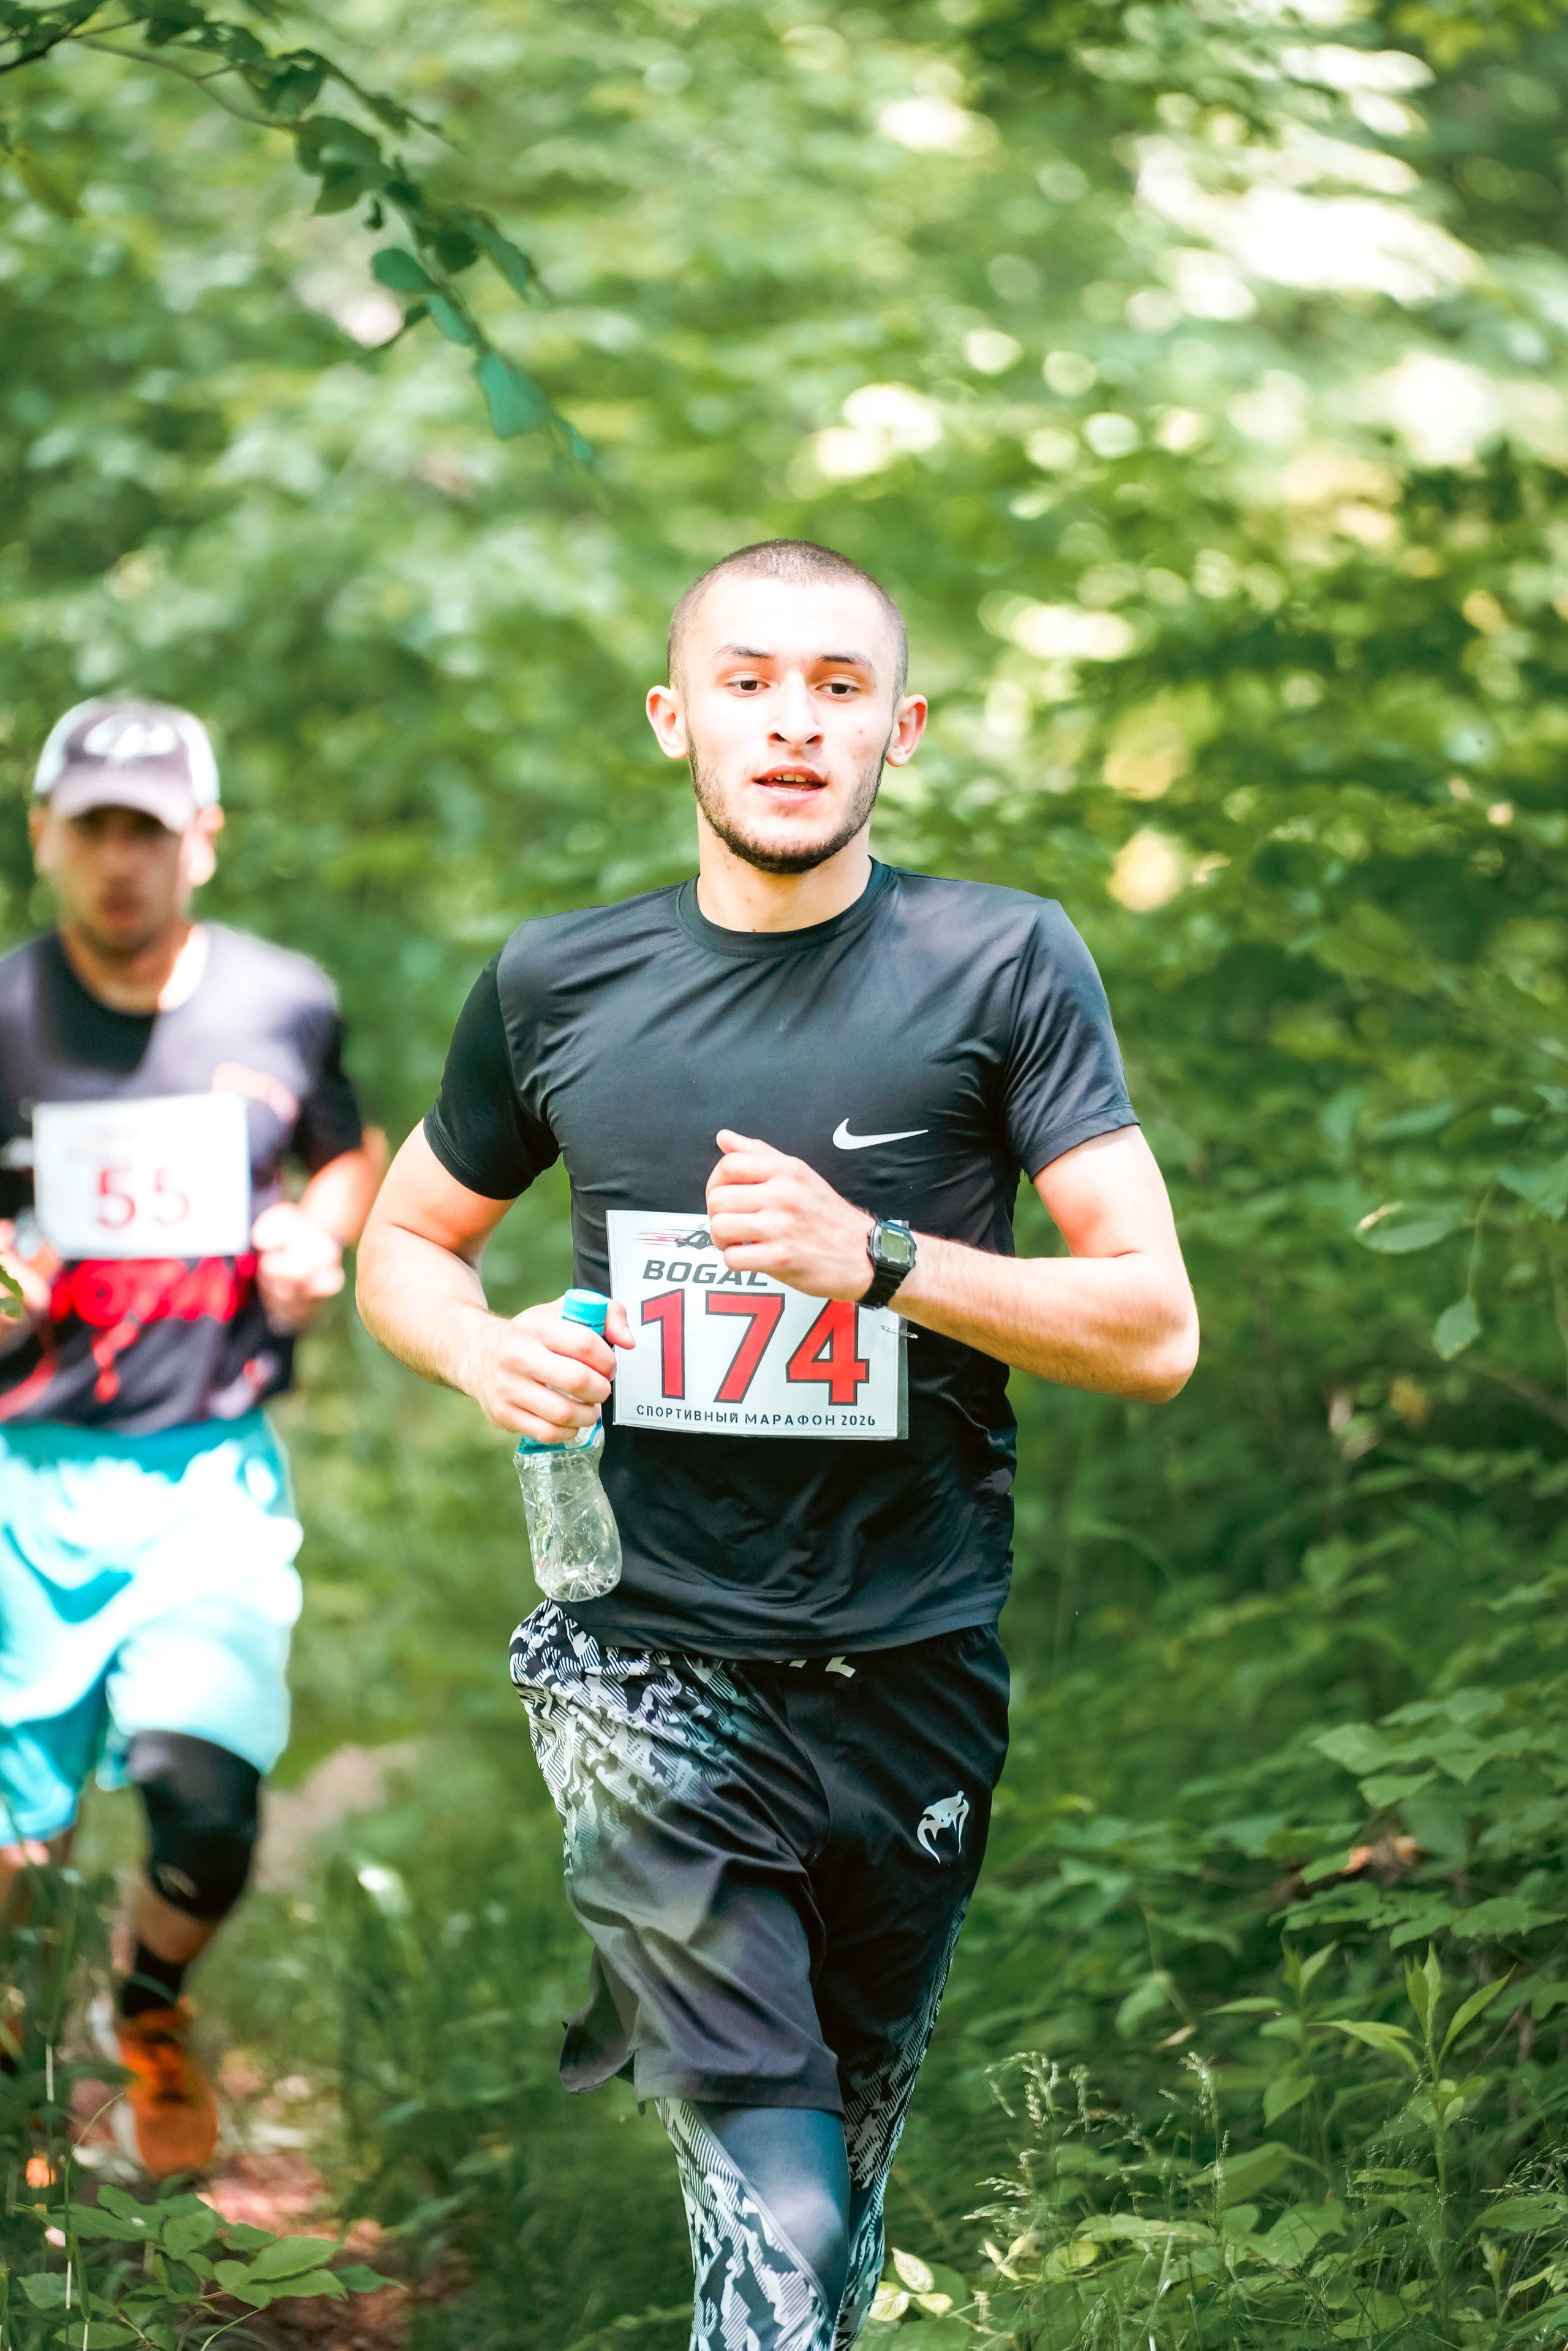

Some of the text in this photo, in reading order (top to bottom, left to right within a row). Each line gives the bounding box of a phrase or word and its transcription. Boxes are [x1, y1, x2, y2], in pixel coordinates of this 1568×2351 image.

[96, 1166, 190, 1229] 55
[641, 1288, 870, 1406] 174
[636, 1405, 875, 1426] СПОРТИВНЫЙ МАРАФОН 2026
